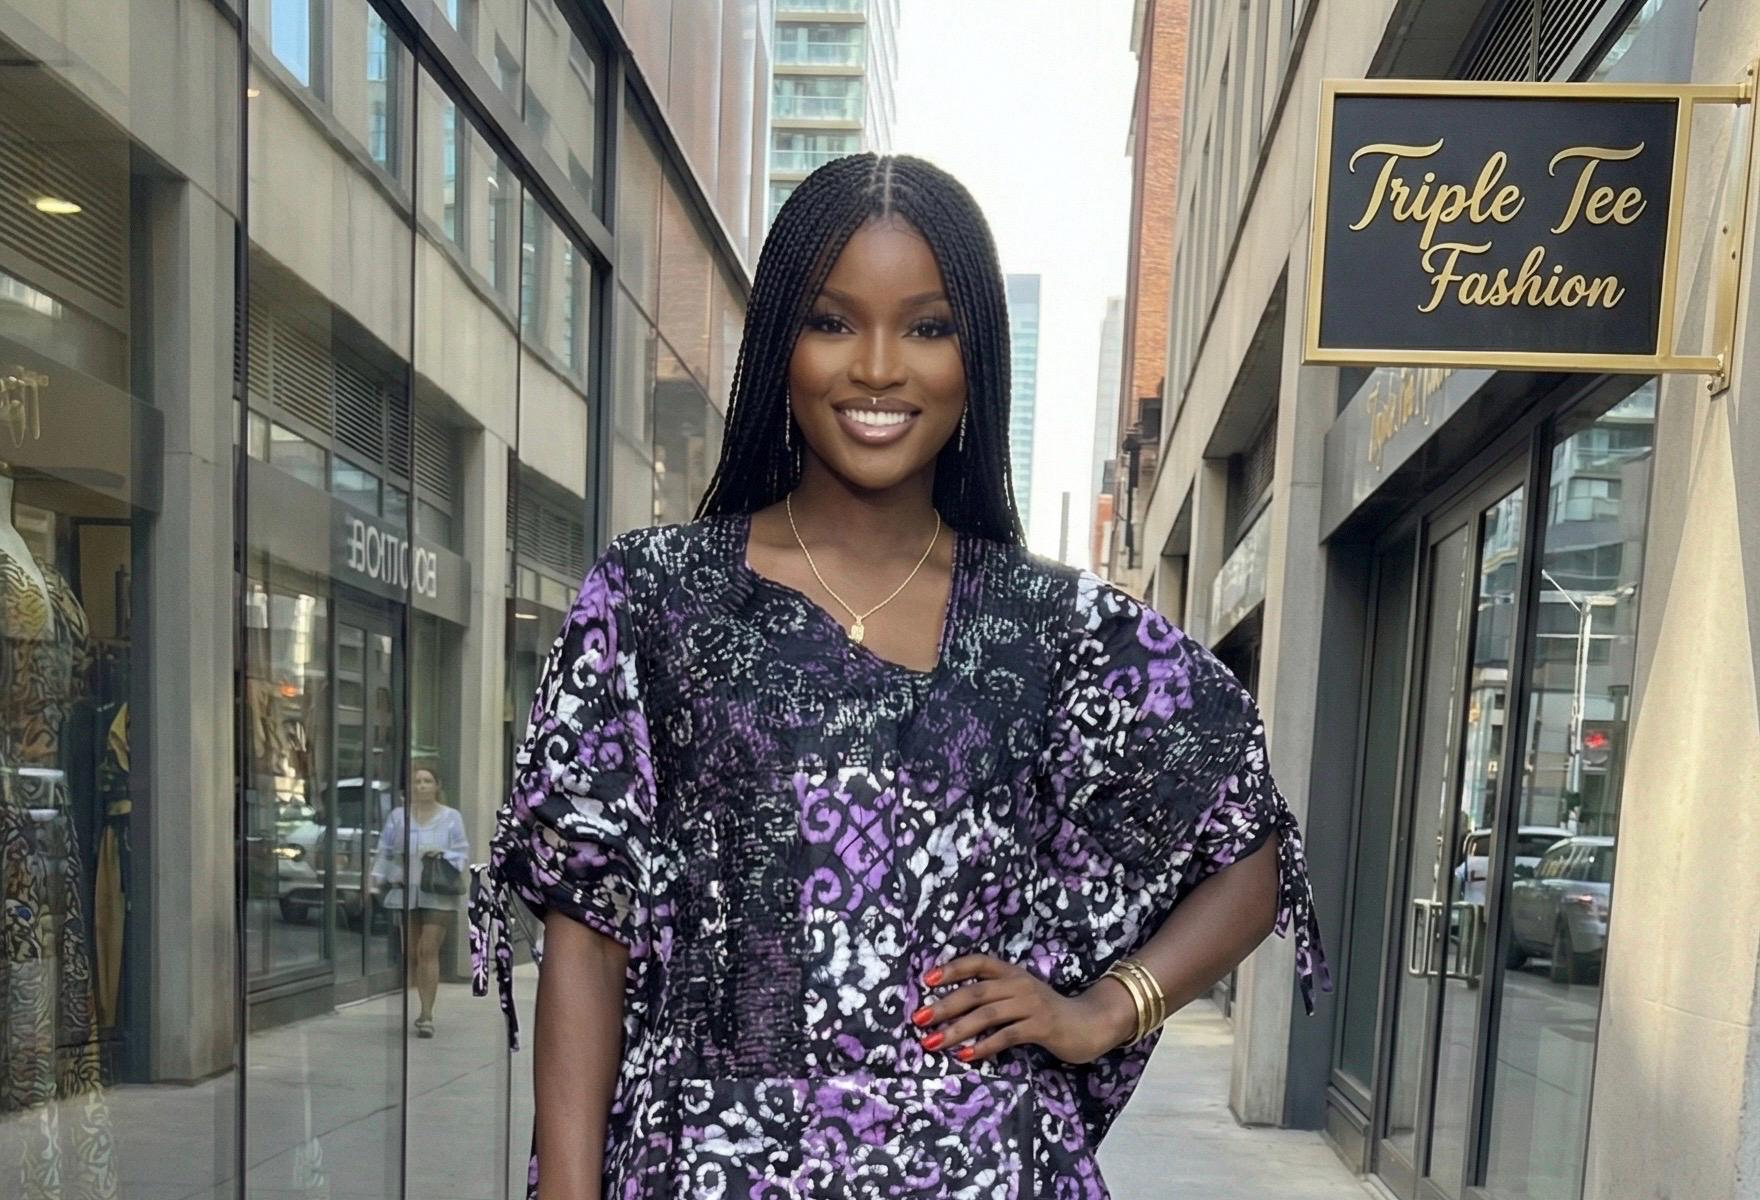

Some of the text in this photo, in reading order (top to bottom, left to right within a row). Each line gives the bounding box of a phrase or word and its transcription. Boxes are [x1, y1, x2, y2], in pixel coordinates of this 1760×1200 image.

[1349, 138, 1647, 250] Triple Tee
[1418, 241, 1625, 313] Fashion
